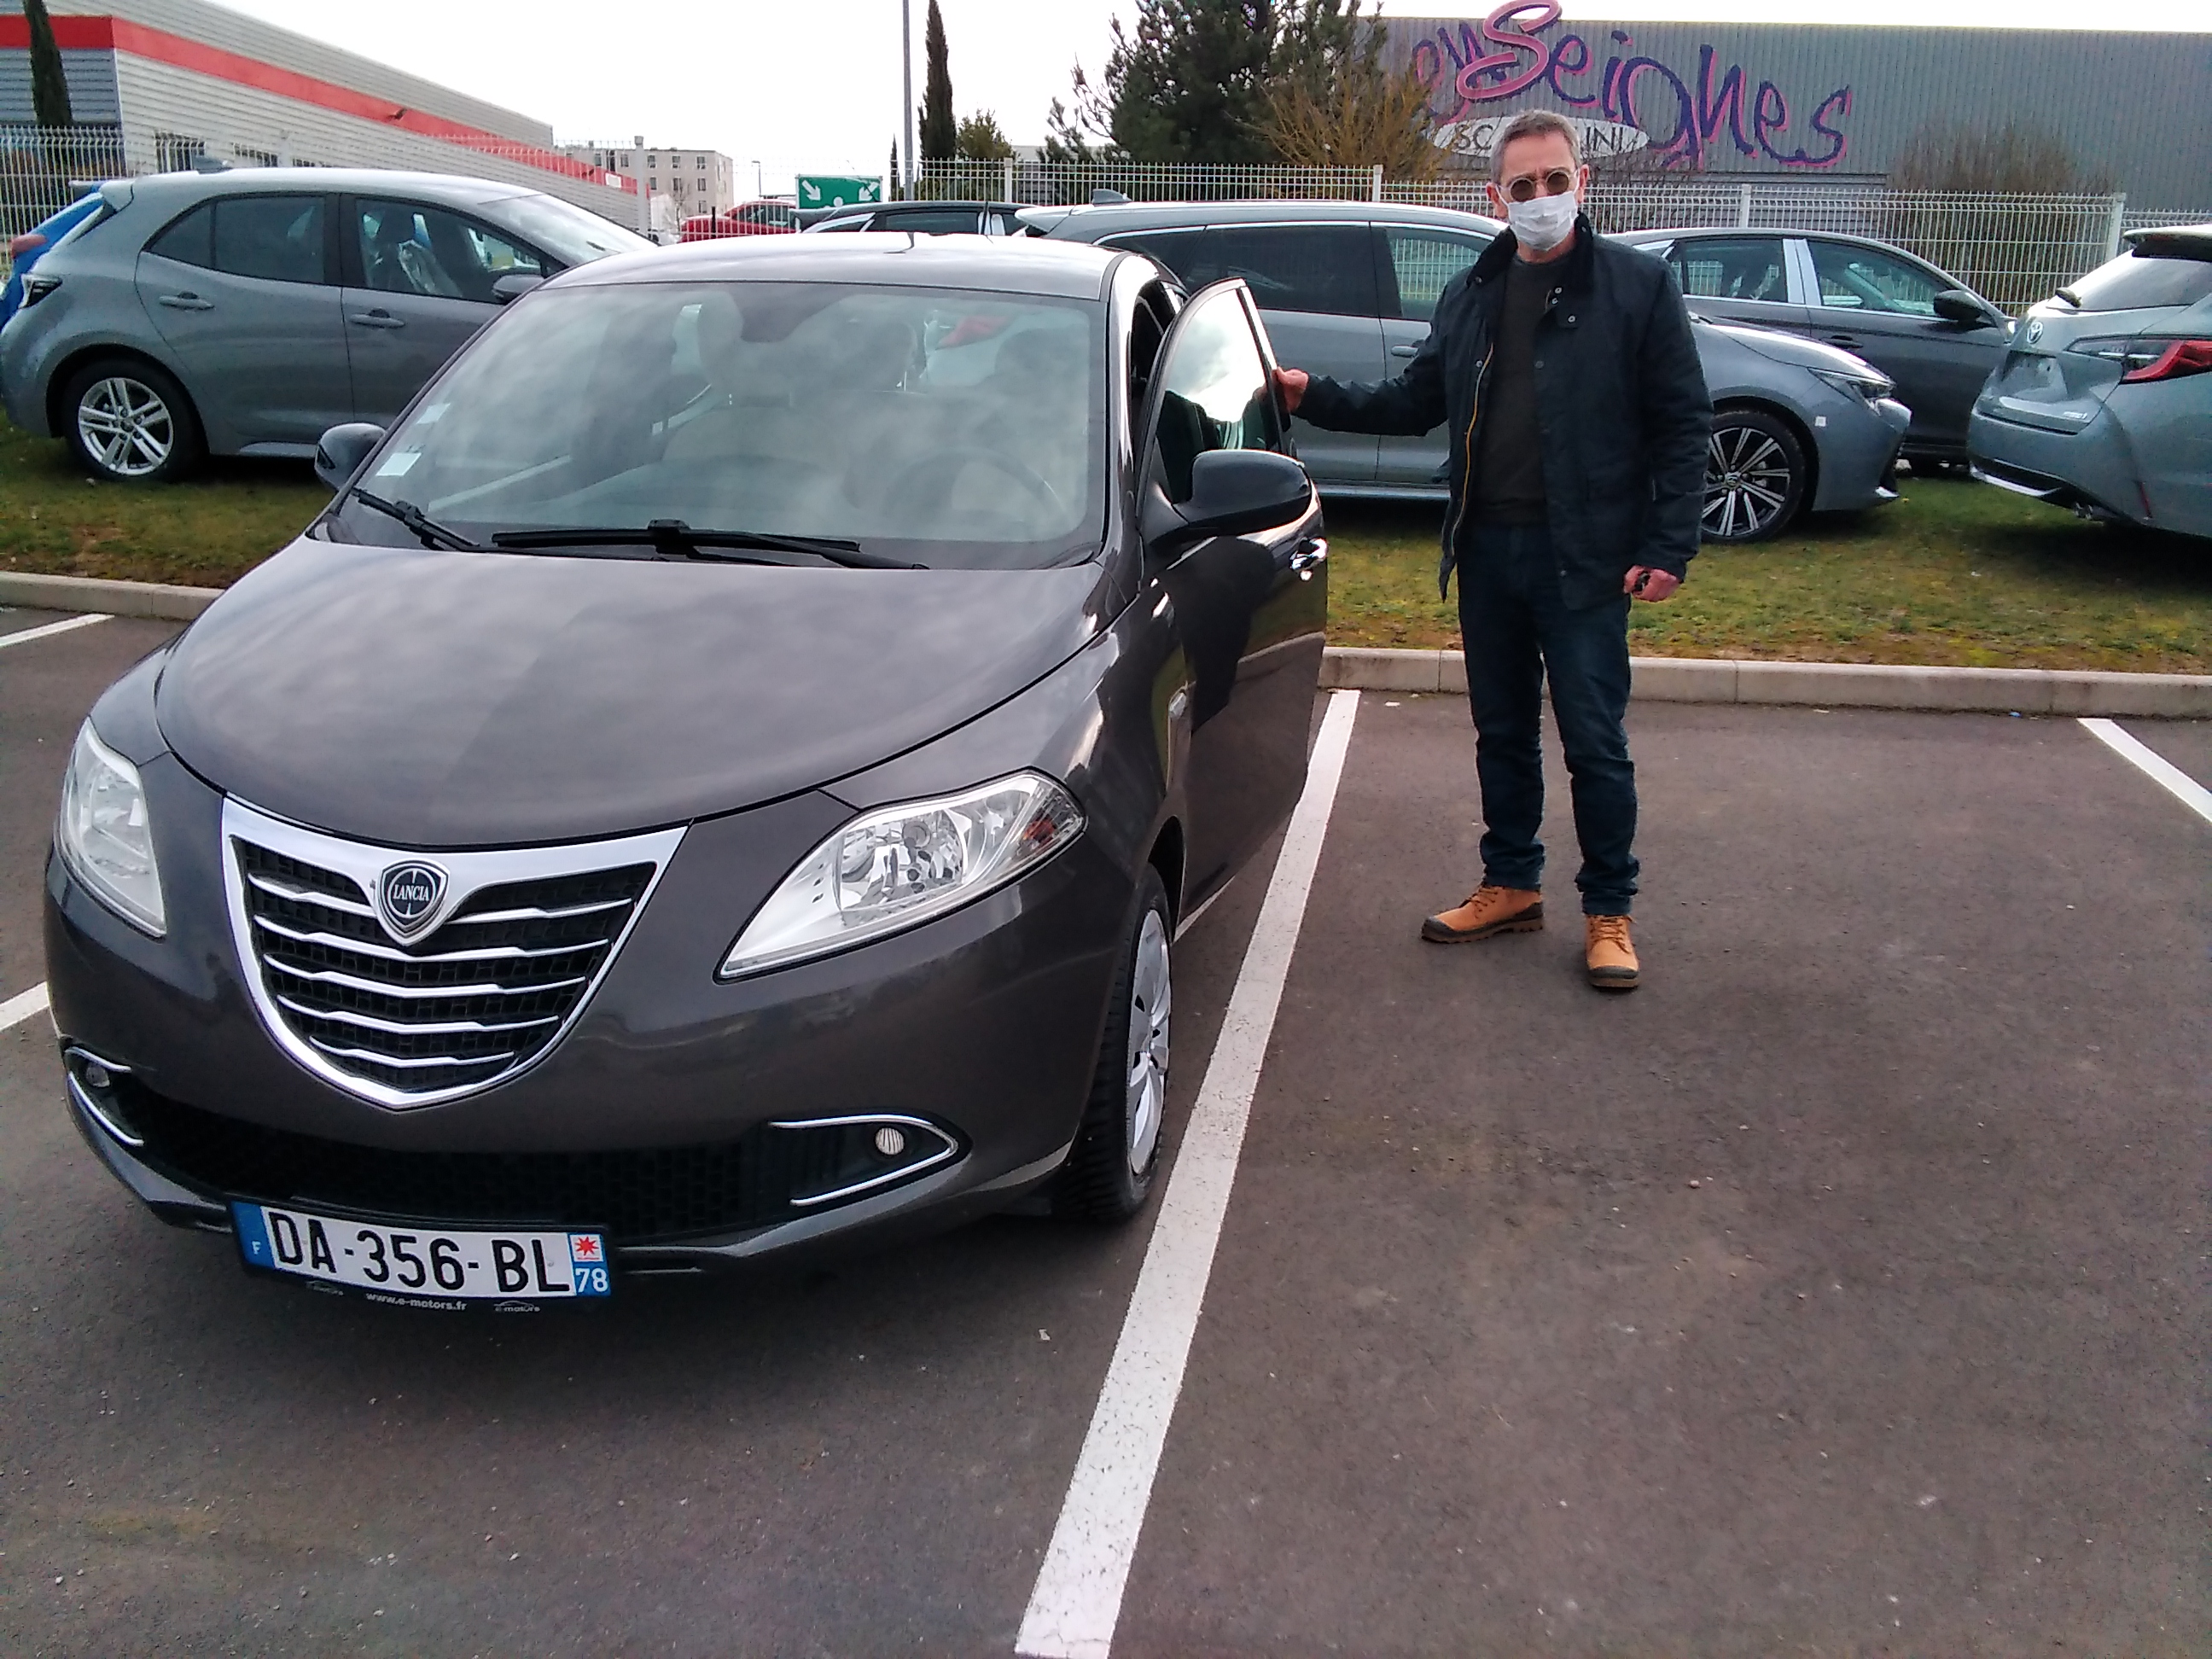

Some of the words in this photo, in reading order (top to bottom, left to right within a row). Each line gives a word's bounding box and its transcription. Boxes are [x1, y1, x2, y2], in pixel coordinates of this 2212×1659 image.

[393, 884, 429, 901] LANCIA
[252, 1240, 261, 1254] F
[268, 1211, 570, 1292] DA-356-BL
[575, 1267, 608, 1293] 78
[365, 1293, 468, 1311] www.e-motors.fr
